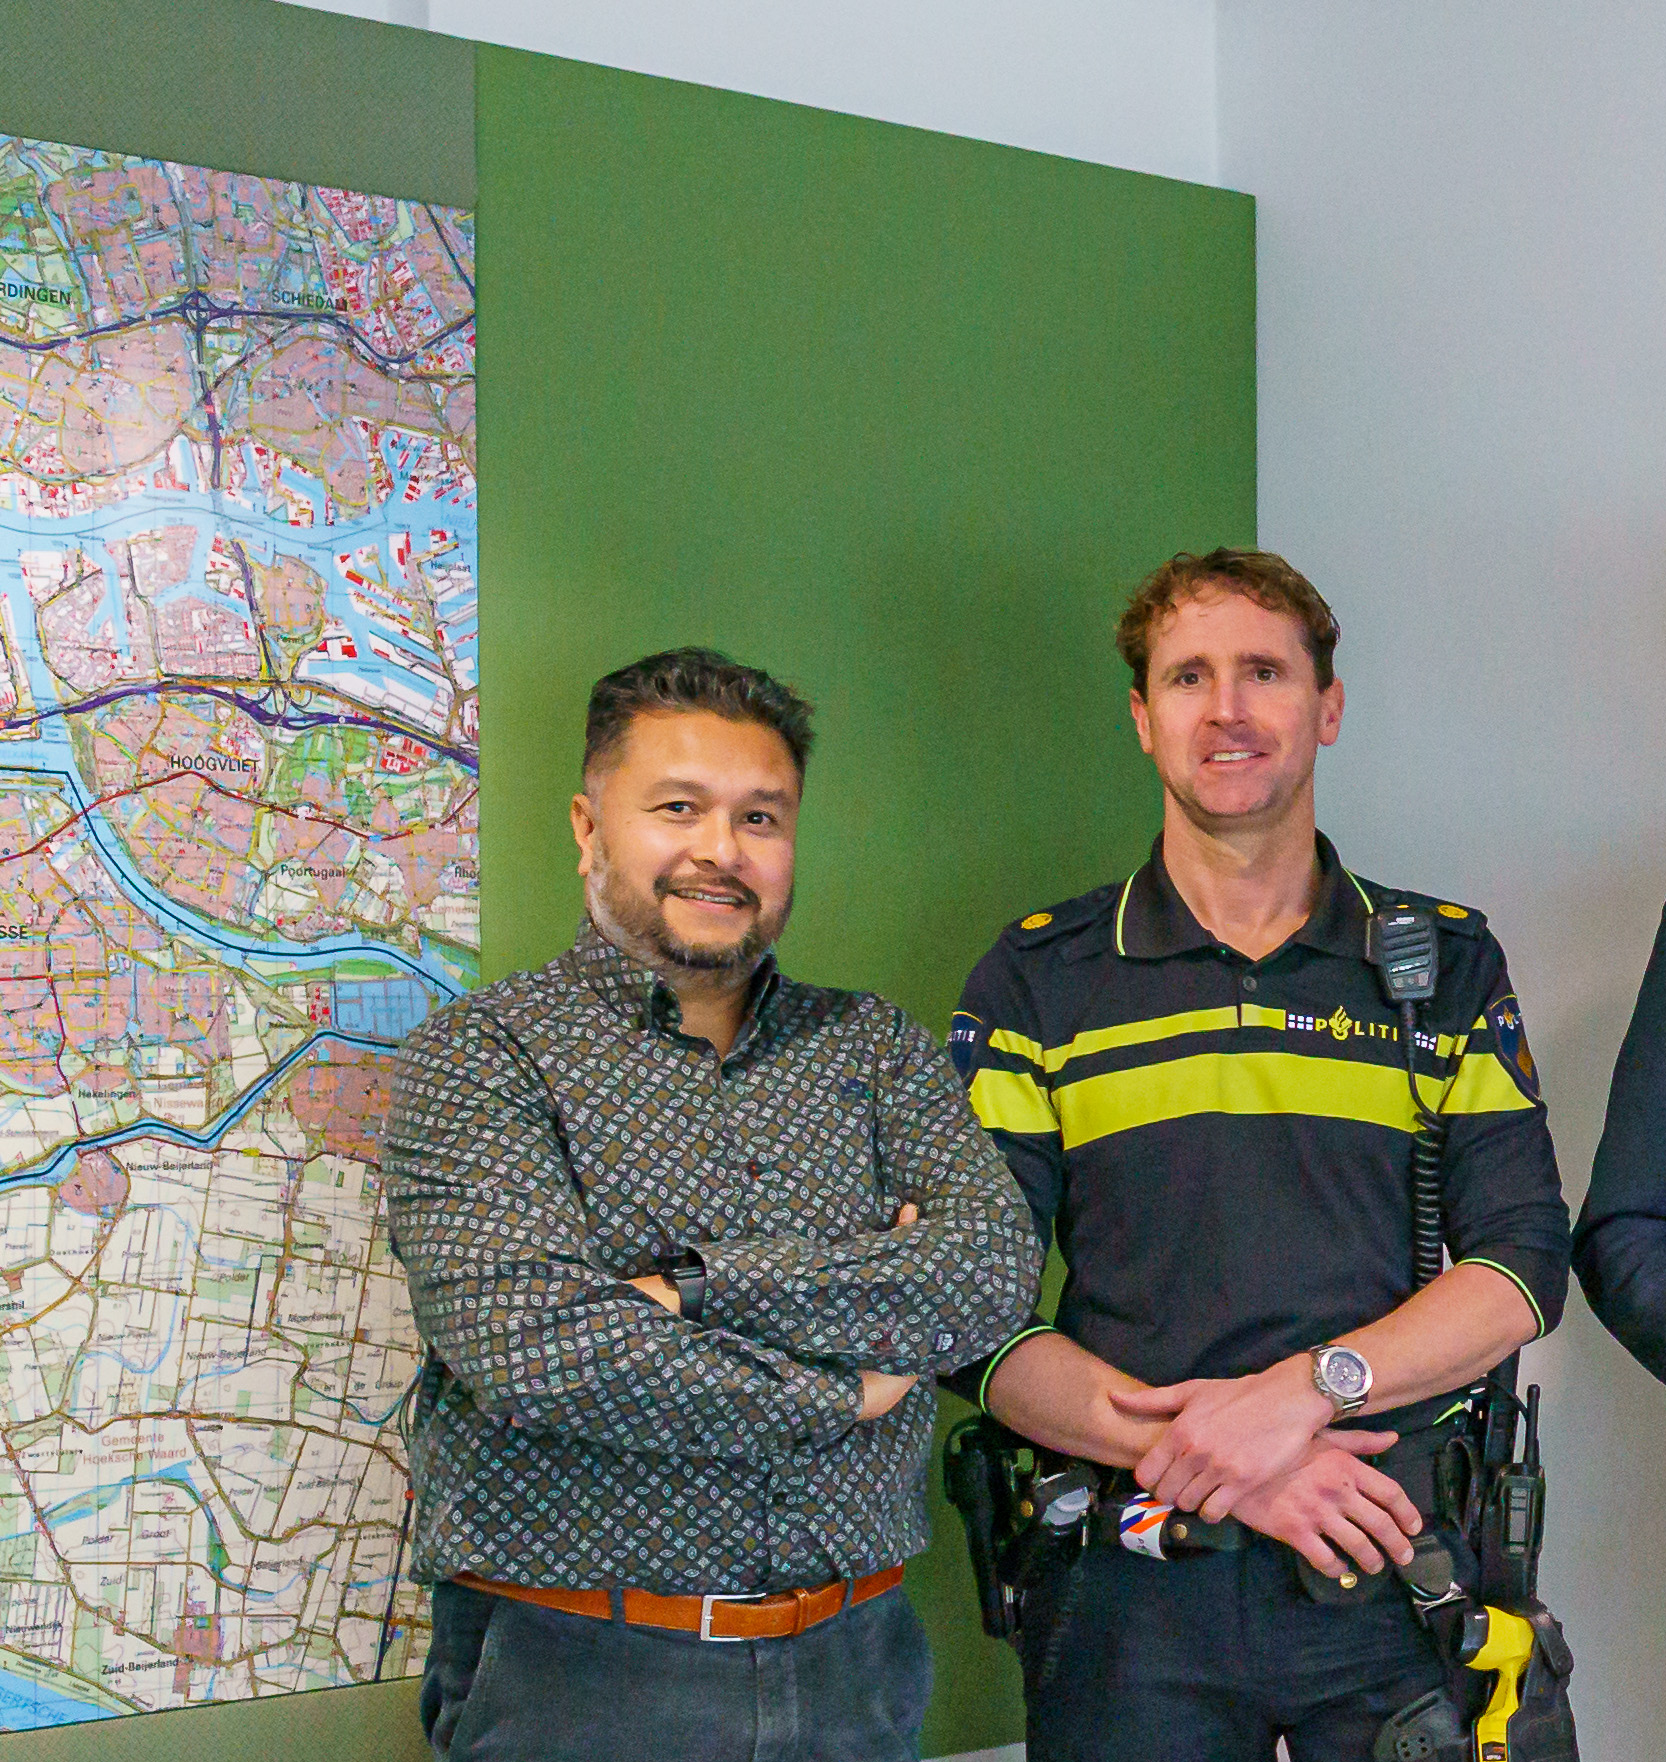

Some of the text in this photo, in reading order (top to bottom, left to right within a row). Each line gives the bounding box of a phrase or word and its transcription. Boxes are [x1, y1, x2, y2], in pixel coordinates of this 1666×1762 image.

[272, 289, 348, 312] SCHIEDAM
[170, 756, 260, 773] HOOGVLIET
[280, 865, 347, 880] Poortugaal
[1315, 1005, 1398, 1042] POLITI
[126, 1161, 213, 1173] Nieuw-Beijerland
[101, 1433, 165, 1446] Gemeente
[148, 1447, 187, 1460] Waard
[101, 1657, 179, 1675] Zuid-Beijerland
